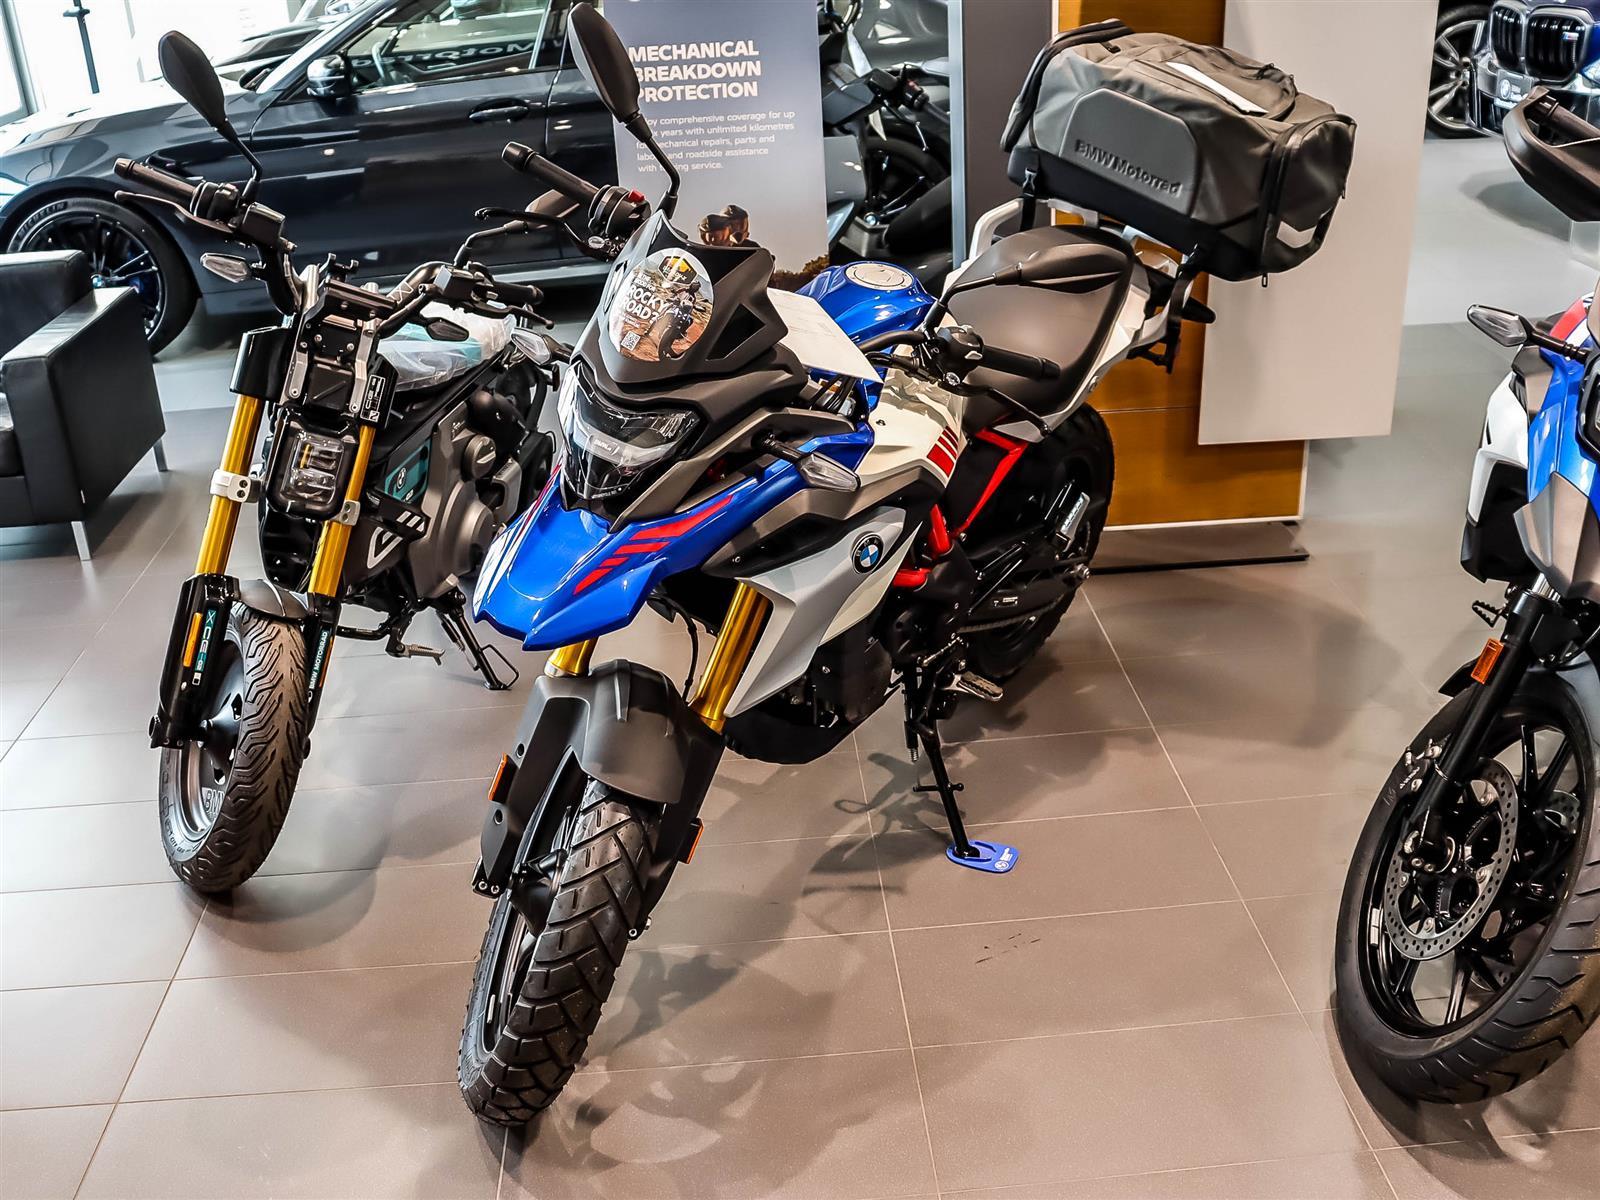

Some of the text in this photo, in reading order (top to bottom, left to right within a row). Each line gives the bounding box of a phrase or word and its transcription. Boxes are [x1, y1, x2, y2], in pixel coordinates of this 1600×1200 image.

[628, 40, 760, 63] MECHANICAL
[635, 60, 761, 83] BREAKDOWN
[660, 114, 724, 126] comprehensive
[727, 112, 767, 122] coverage
[769, 110, 781, 119] for
[783, 111, 796, 120] up
[660, 129, 683, 139] years
[685, 127, 705, 135] with
[707, 124, 747, 135] unlimited
[749, 123, 795, 132] kilometres
[735, 136, 757, 146] parts
[759, 134, 775, 143] and
[685, 149, 722, 159] roadside
[725, 148, 769, 157] assistance
[638, 164, 657, 172] with
[1074, 139, 1184, 199] BMW Motorrad
[626, 284, 669, 314] ROCKY
[308, 631, 329, 690] BMW MOTORRAD
